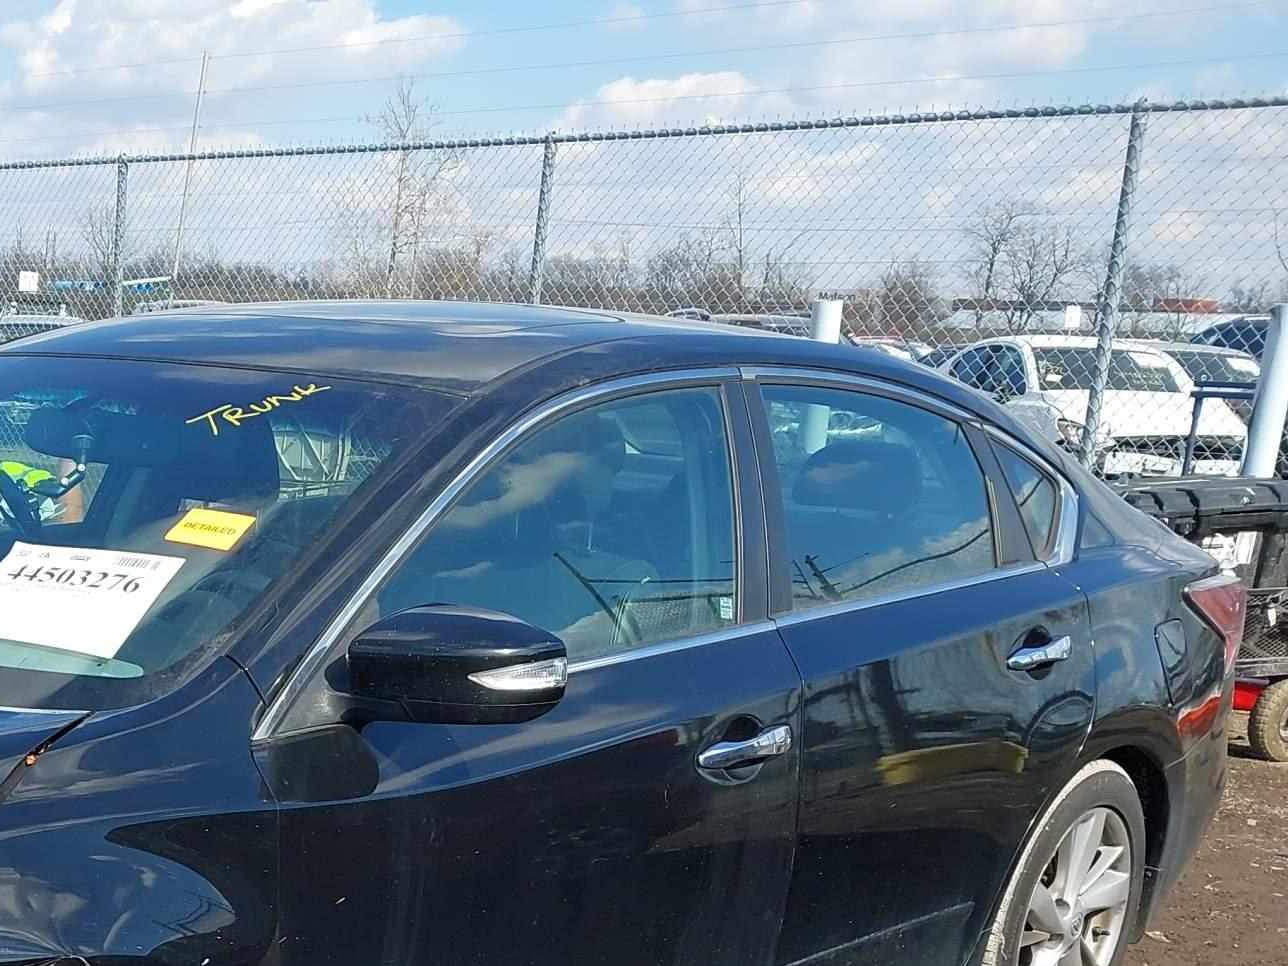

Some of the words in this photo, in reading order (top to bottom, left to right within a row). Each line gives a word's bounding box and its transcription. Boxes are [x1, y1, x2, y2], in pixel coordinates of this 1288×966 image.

[185, 383, 332, 436] TRUNK
[183, 521, 237, 536] DETAILED
[7, 564, 145, 593] 44503276
